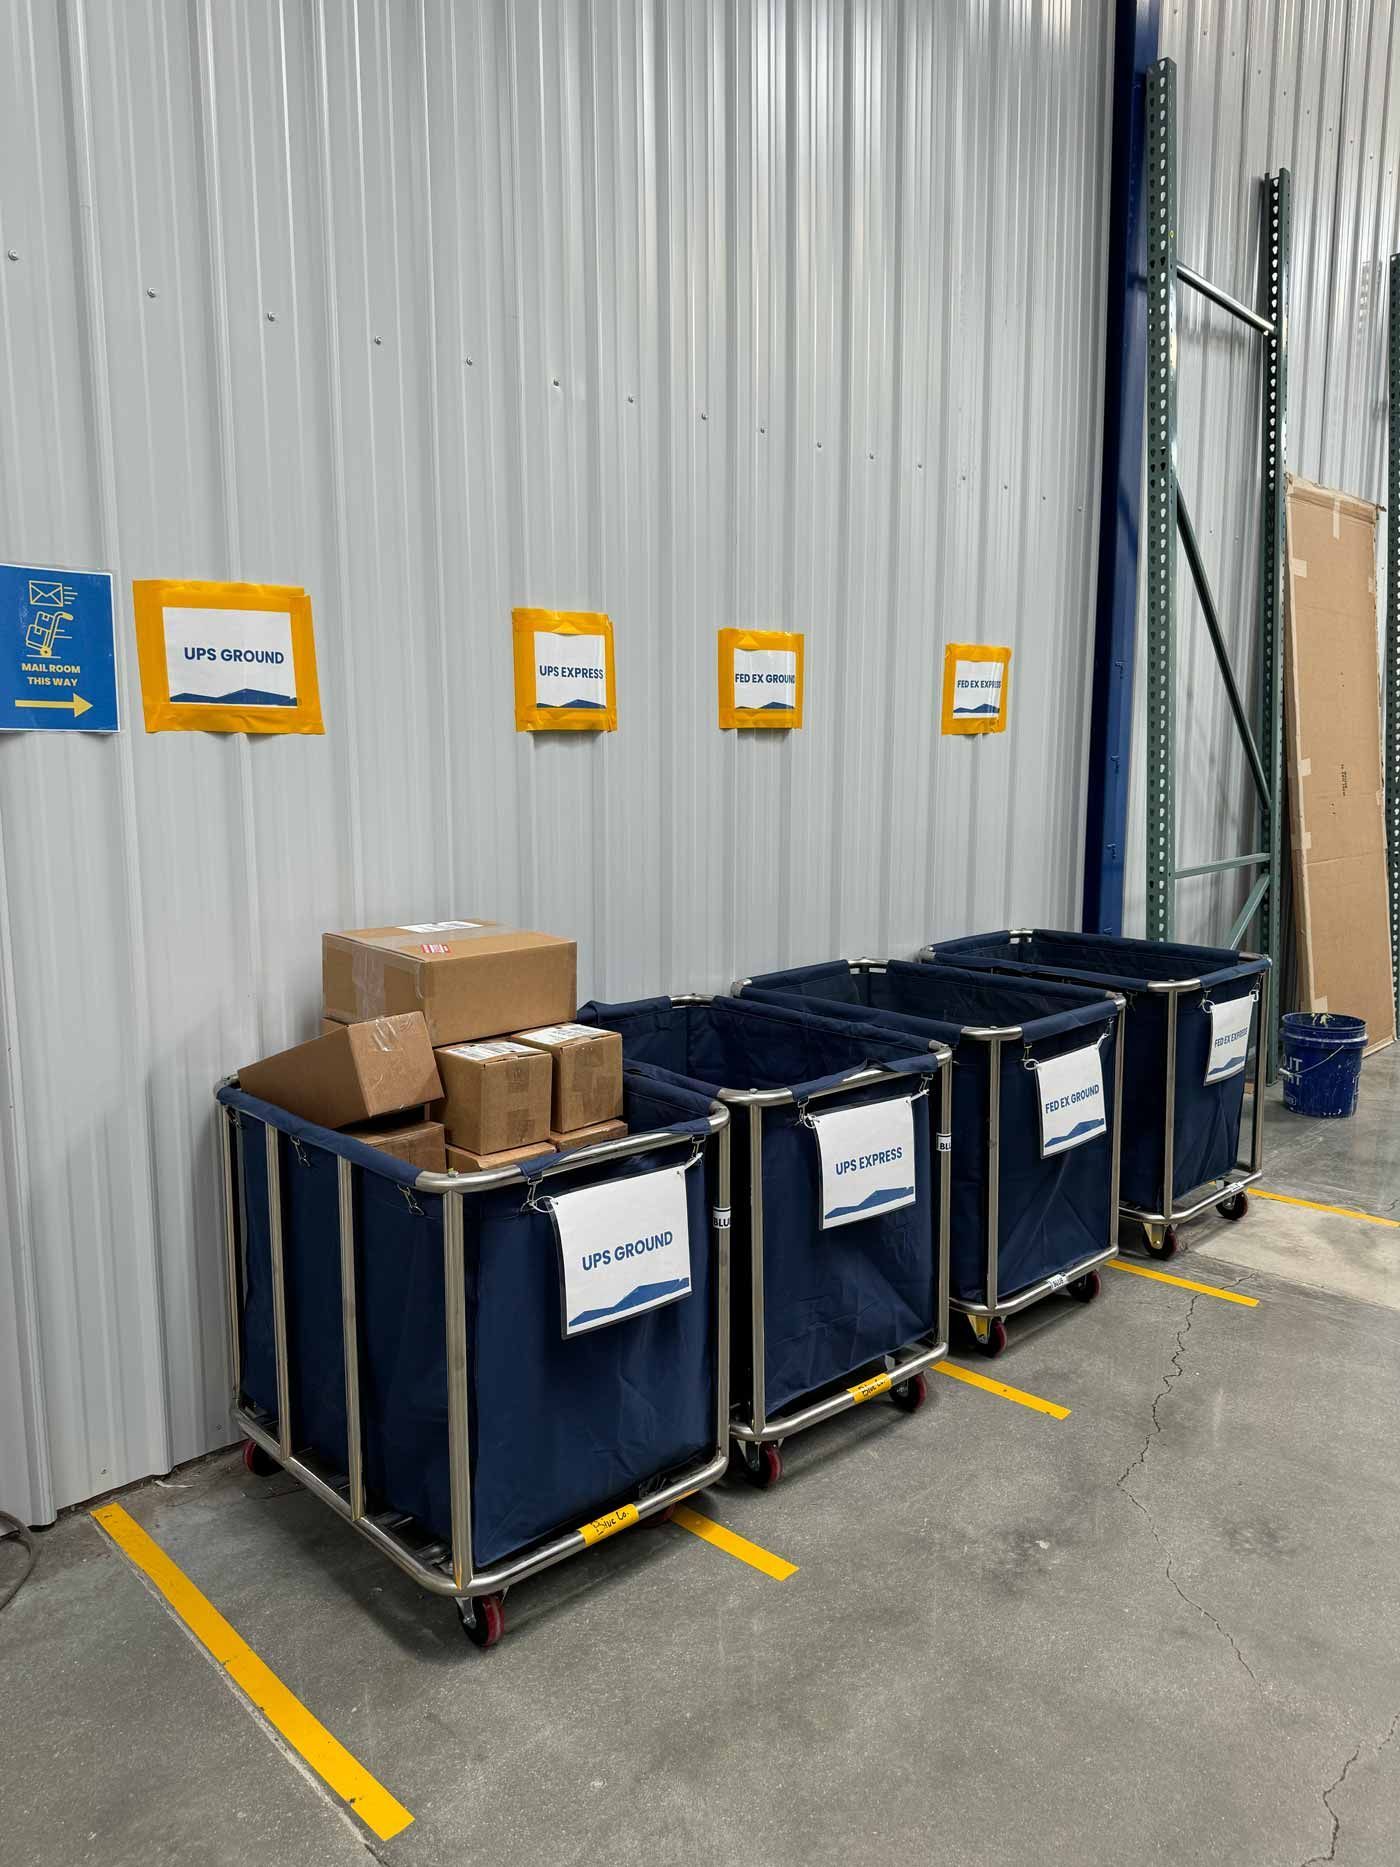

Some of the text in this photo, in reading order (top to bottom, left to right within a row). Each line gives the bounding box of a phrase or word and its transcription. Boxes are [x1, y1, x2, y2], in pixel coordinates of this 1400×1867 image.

[184, 646, 285, 664] UPS GROUND
[21, 663, 81, 674] MAIL ROOM
[539, 665, 604, 680] UPS EXPRESS
[27, 676, 78, 687] THIS WAY
[735, 673, 750, 683] FED
[752, 674, 764, 684] EX
[957, 680, 970, 688] FED
[970, 680, 980, 688] EX
[1214, 1037, 1224, 1048] FED
[1045, 1084, 1100, 1114] FED EX GROUND
[835, 1146, 903, 1176] UPS EXPRESS
[582, 1230, 674, 1271] UPS GROUND
